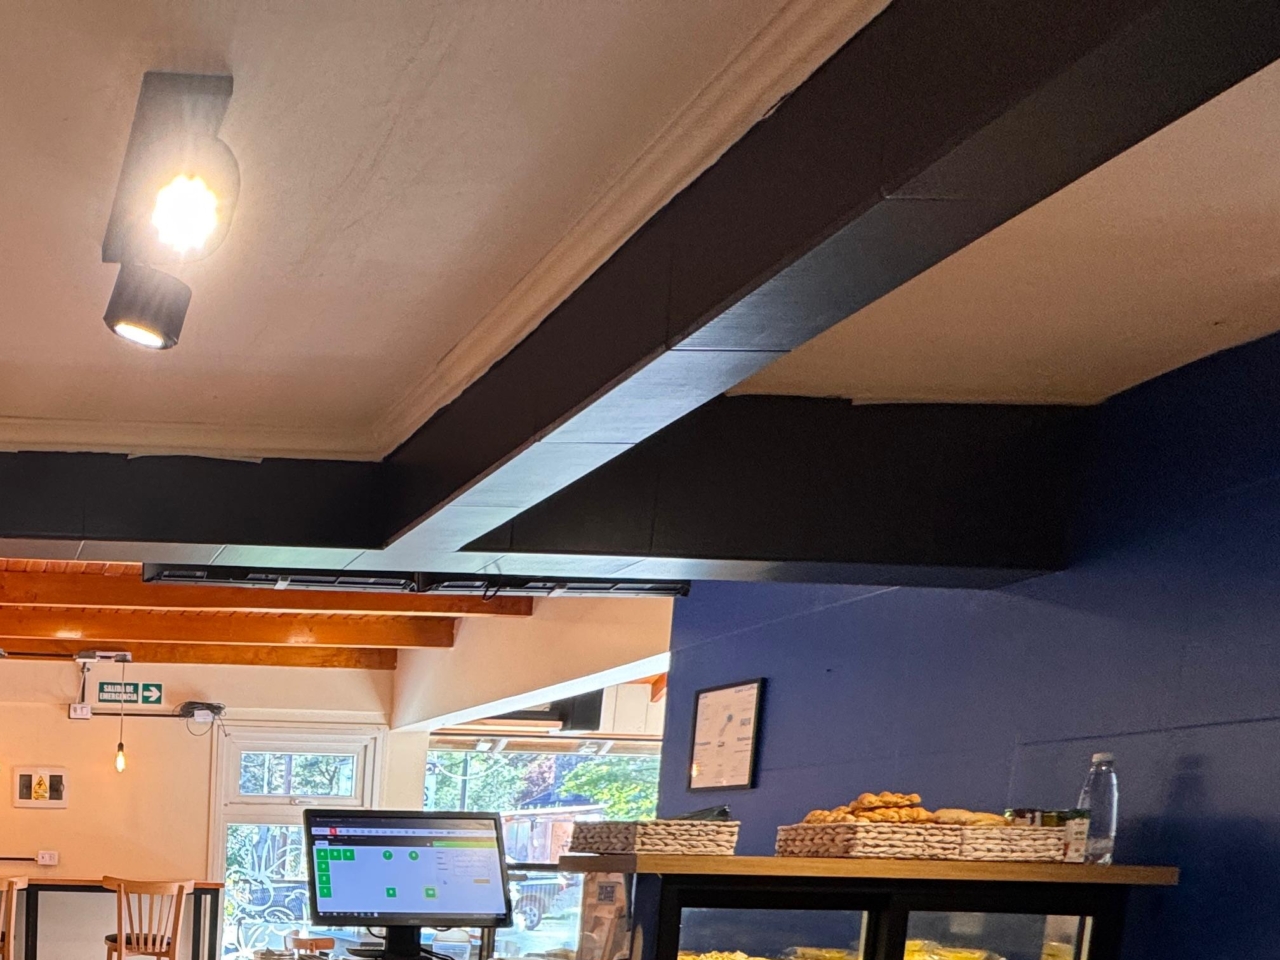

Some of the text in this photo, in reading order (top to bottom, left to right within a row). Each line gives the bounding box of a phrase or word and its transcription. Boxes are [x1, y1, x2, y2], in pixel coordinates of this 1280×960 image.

[103, 684, 134, 693] SALIDA DE
[99, 692, 138, 701] EMERGENCIA
